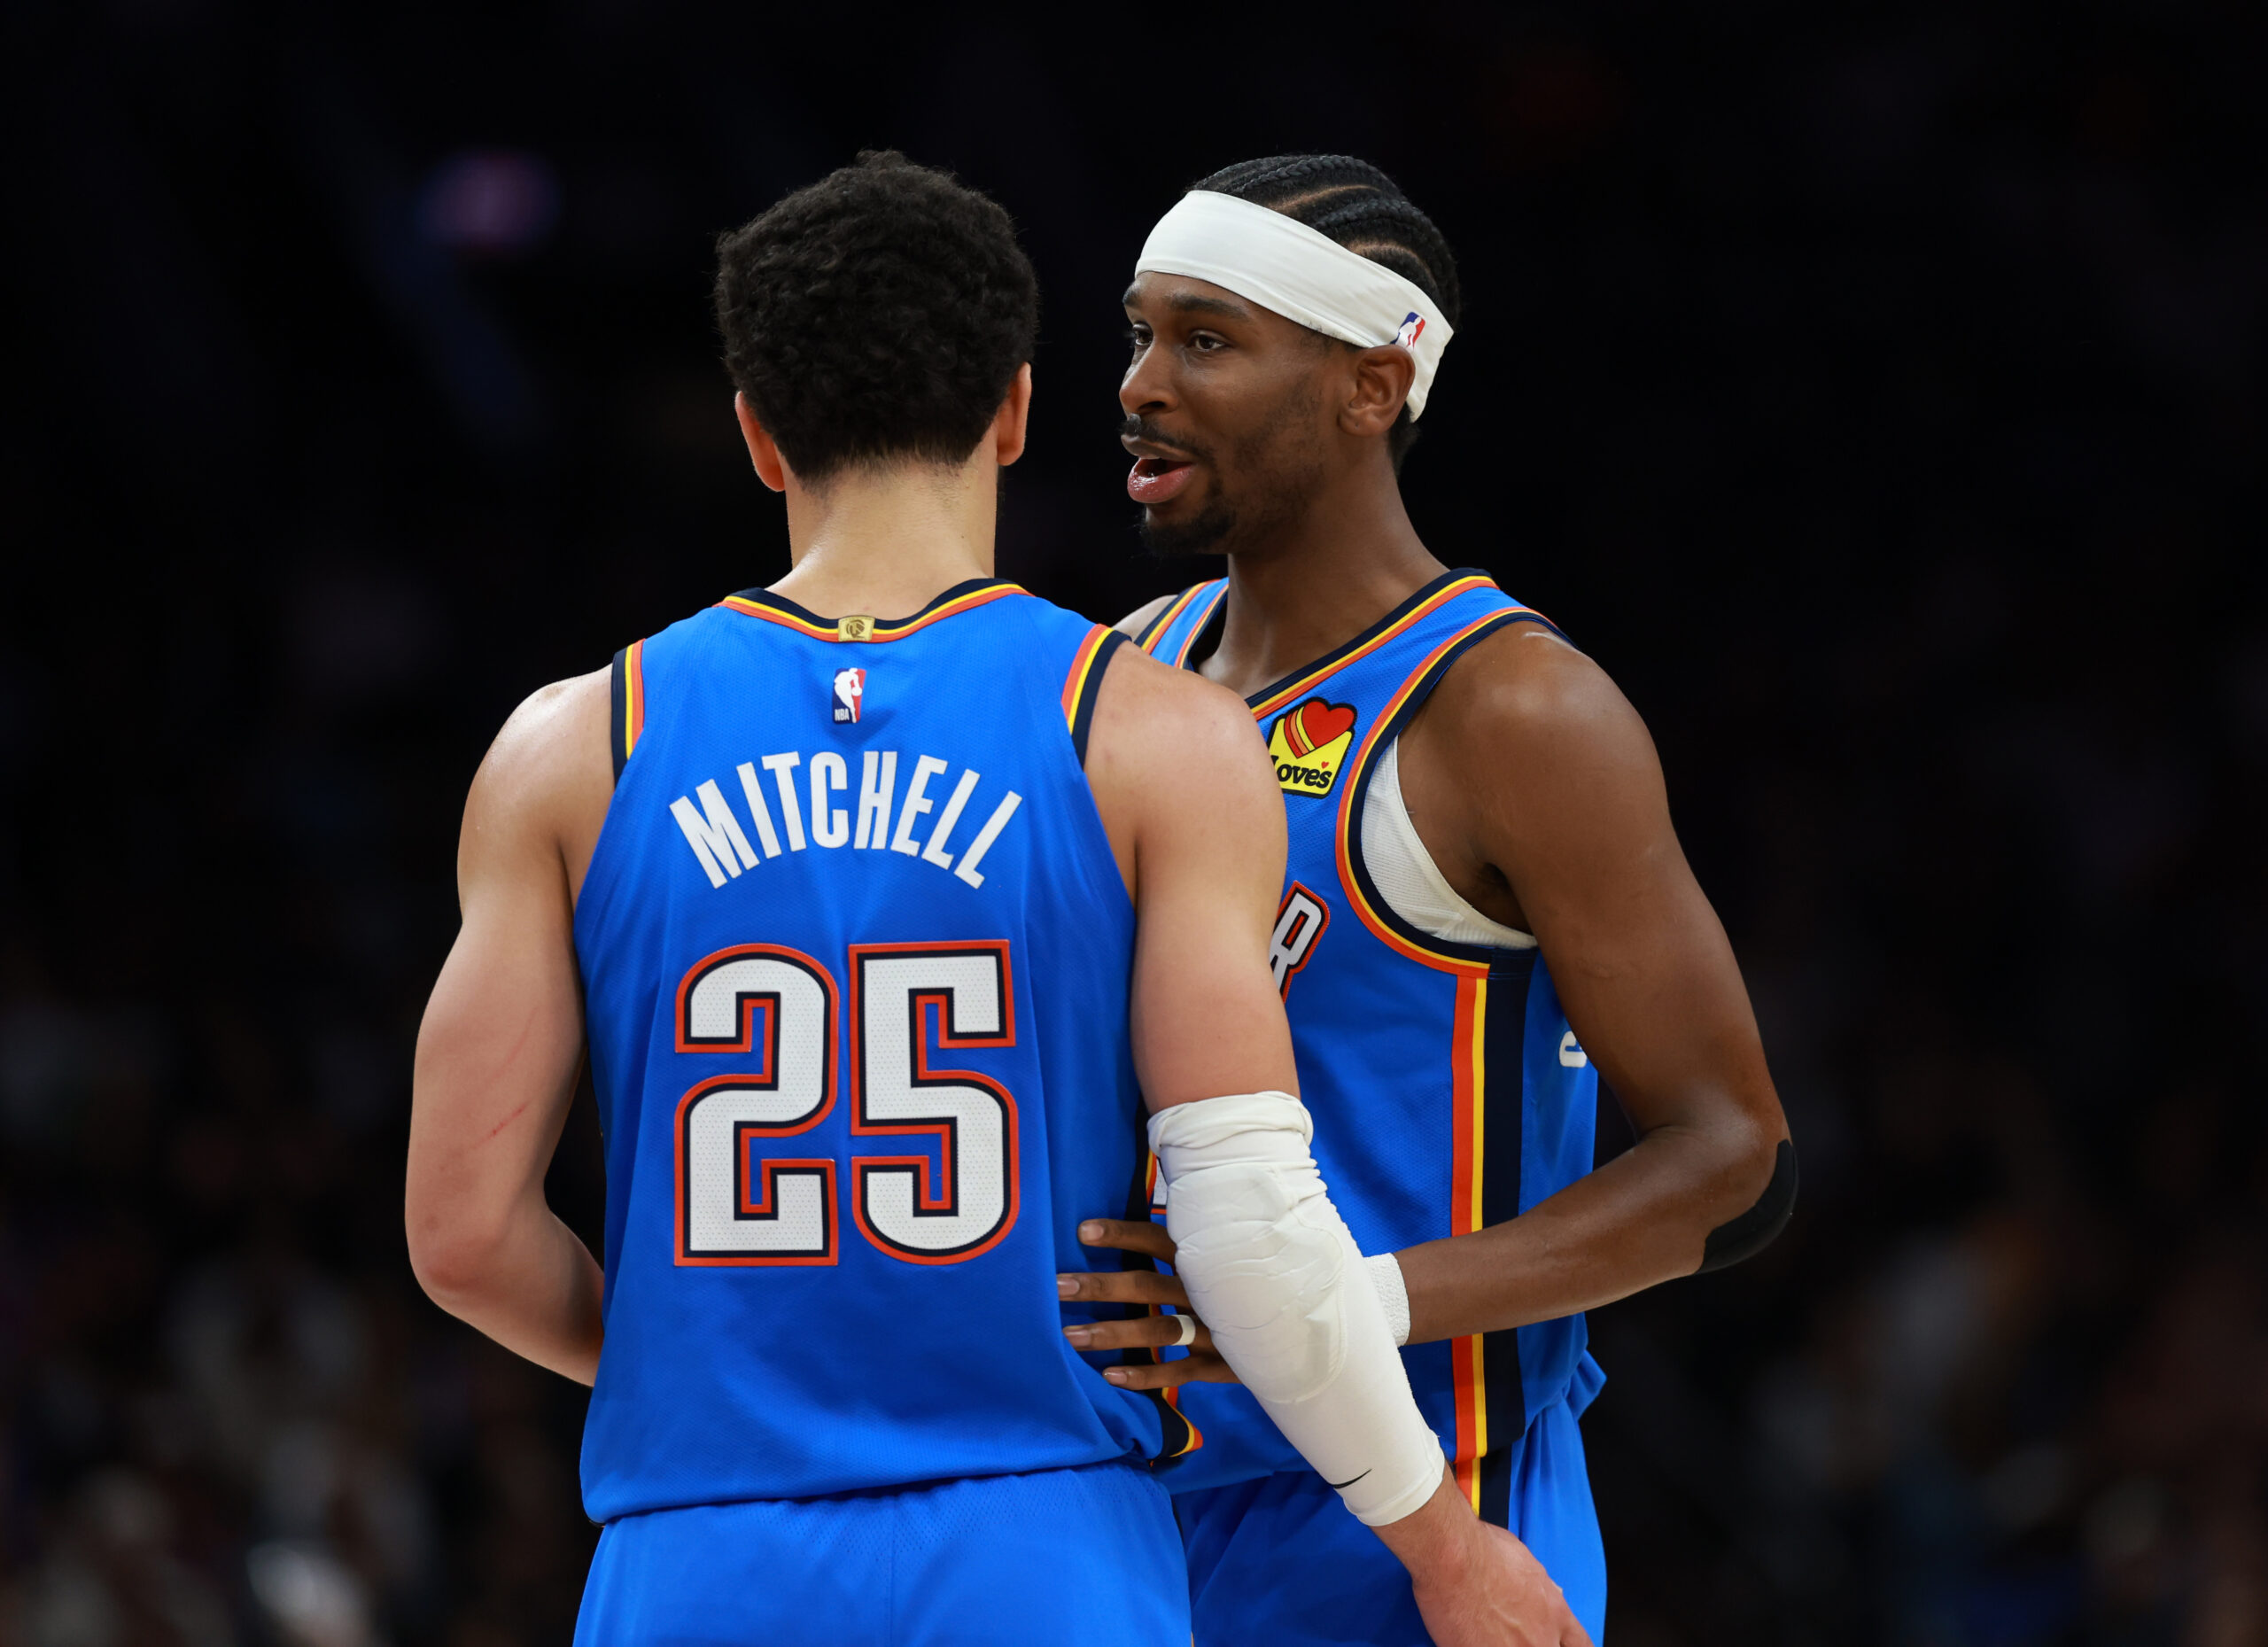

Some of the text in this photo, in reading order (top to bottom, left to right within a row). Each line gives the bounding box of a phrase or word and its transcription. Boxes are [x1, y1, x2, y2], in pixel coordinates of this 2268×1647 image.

[834, 708, 850, 721] NBA
[670, 750, 1022, 889] MITCHELL
[674, 939, 1019, 1266] 25
